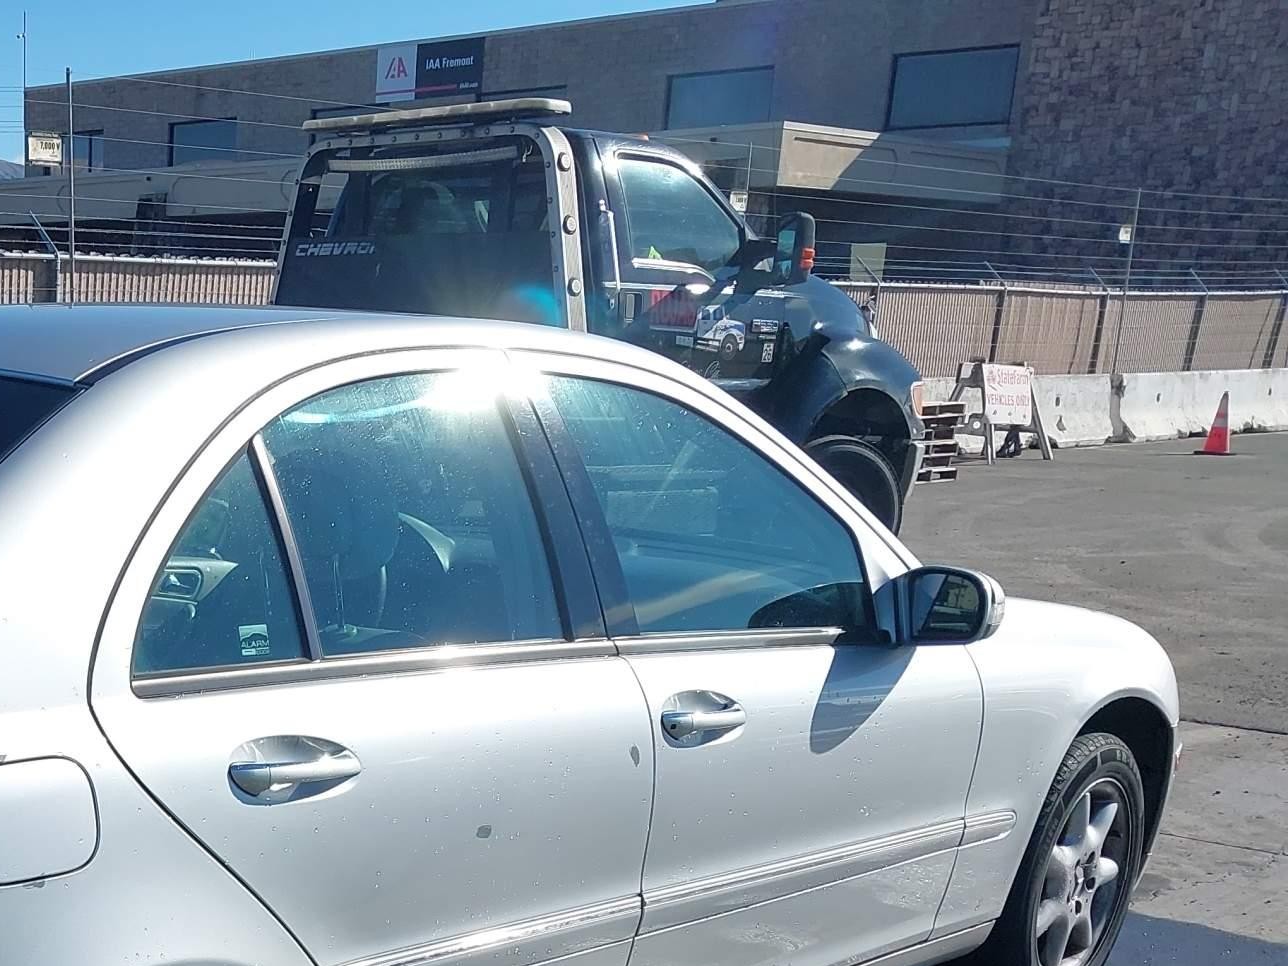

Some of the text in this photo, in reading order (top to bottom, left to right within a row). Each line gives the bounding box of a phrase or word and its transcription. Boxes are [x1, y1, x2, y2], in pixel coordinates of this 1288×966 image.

[425, 55, 474, 70] IAA Fremont
[986, 393, 1015, 406] VEHICLES
[240, 639, 270, 649] ALARM
